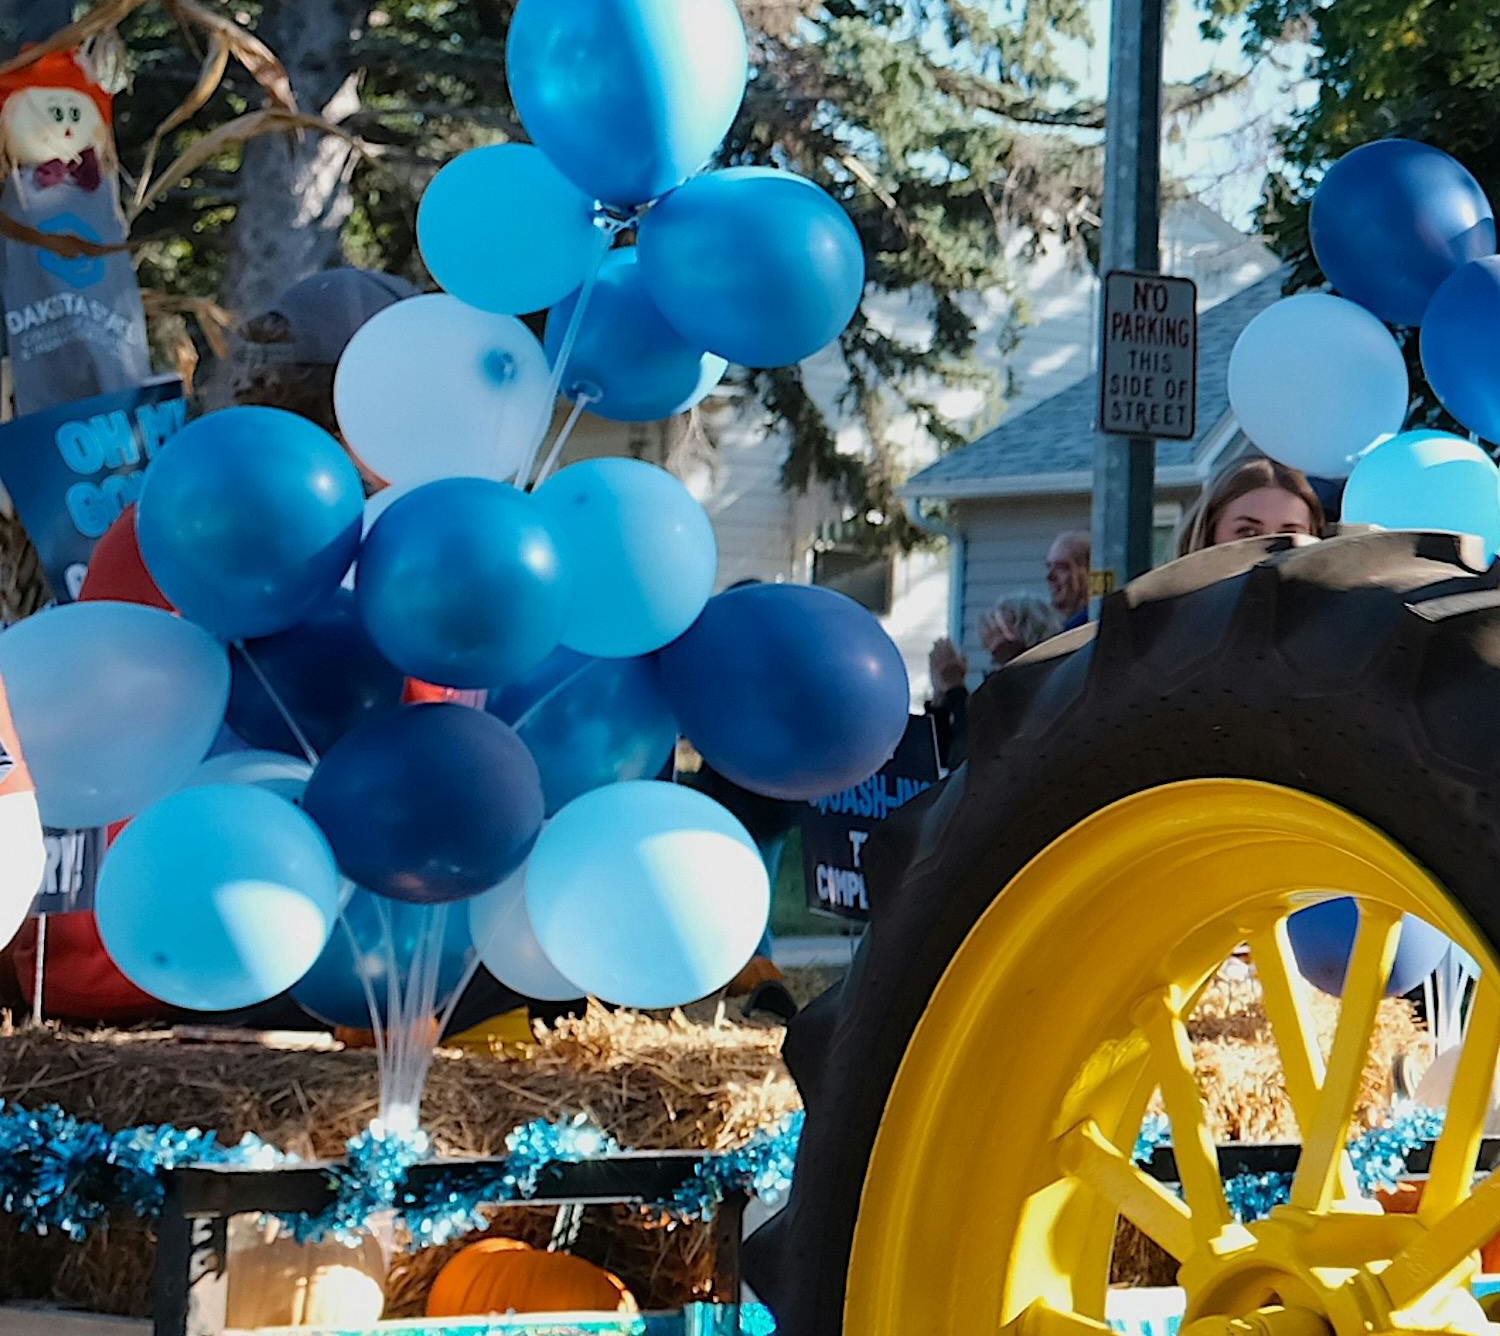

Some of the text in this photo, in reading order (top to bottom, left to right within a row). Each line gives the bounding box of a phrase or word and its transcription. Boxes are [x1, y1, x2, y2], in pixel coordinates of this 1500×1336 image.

[1133, 281, 1168, 313] NO
[1111, 312, 1189, 348] PARKING
[1128, 350, 1173, 374] THIS
[1109, 374, 1189, 399] SIDE OF
[1111, 401, 1188, 427] STREET
[55, 410, 140, 475] OH
